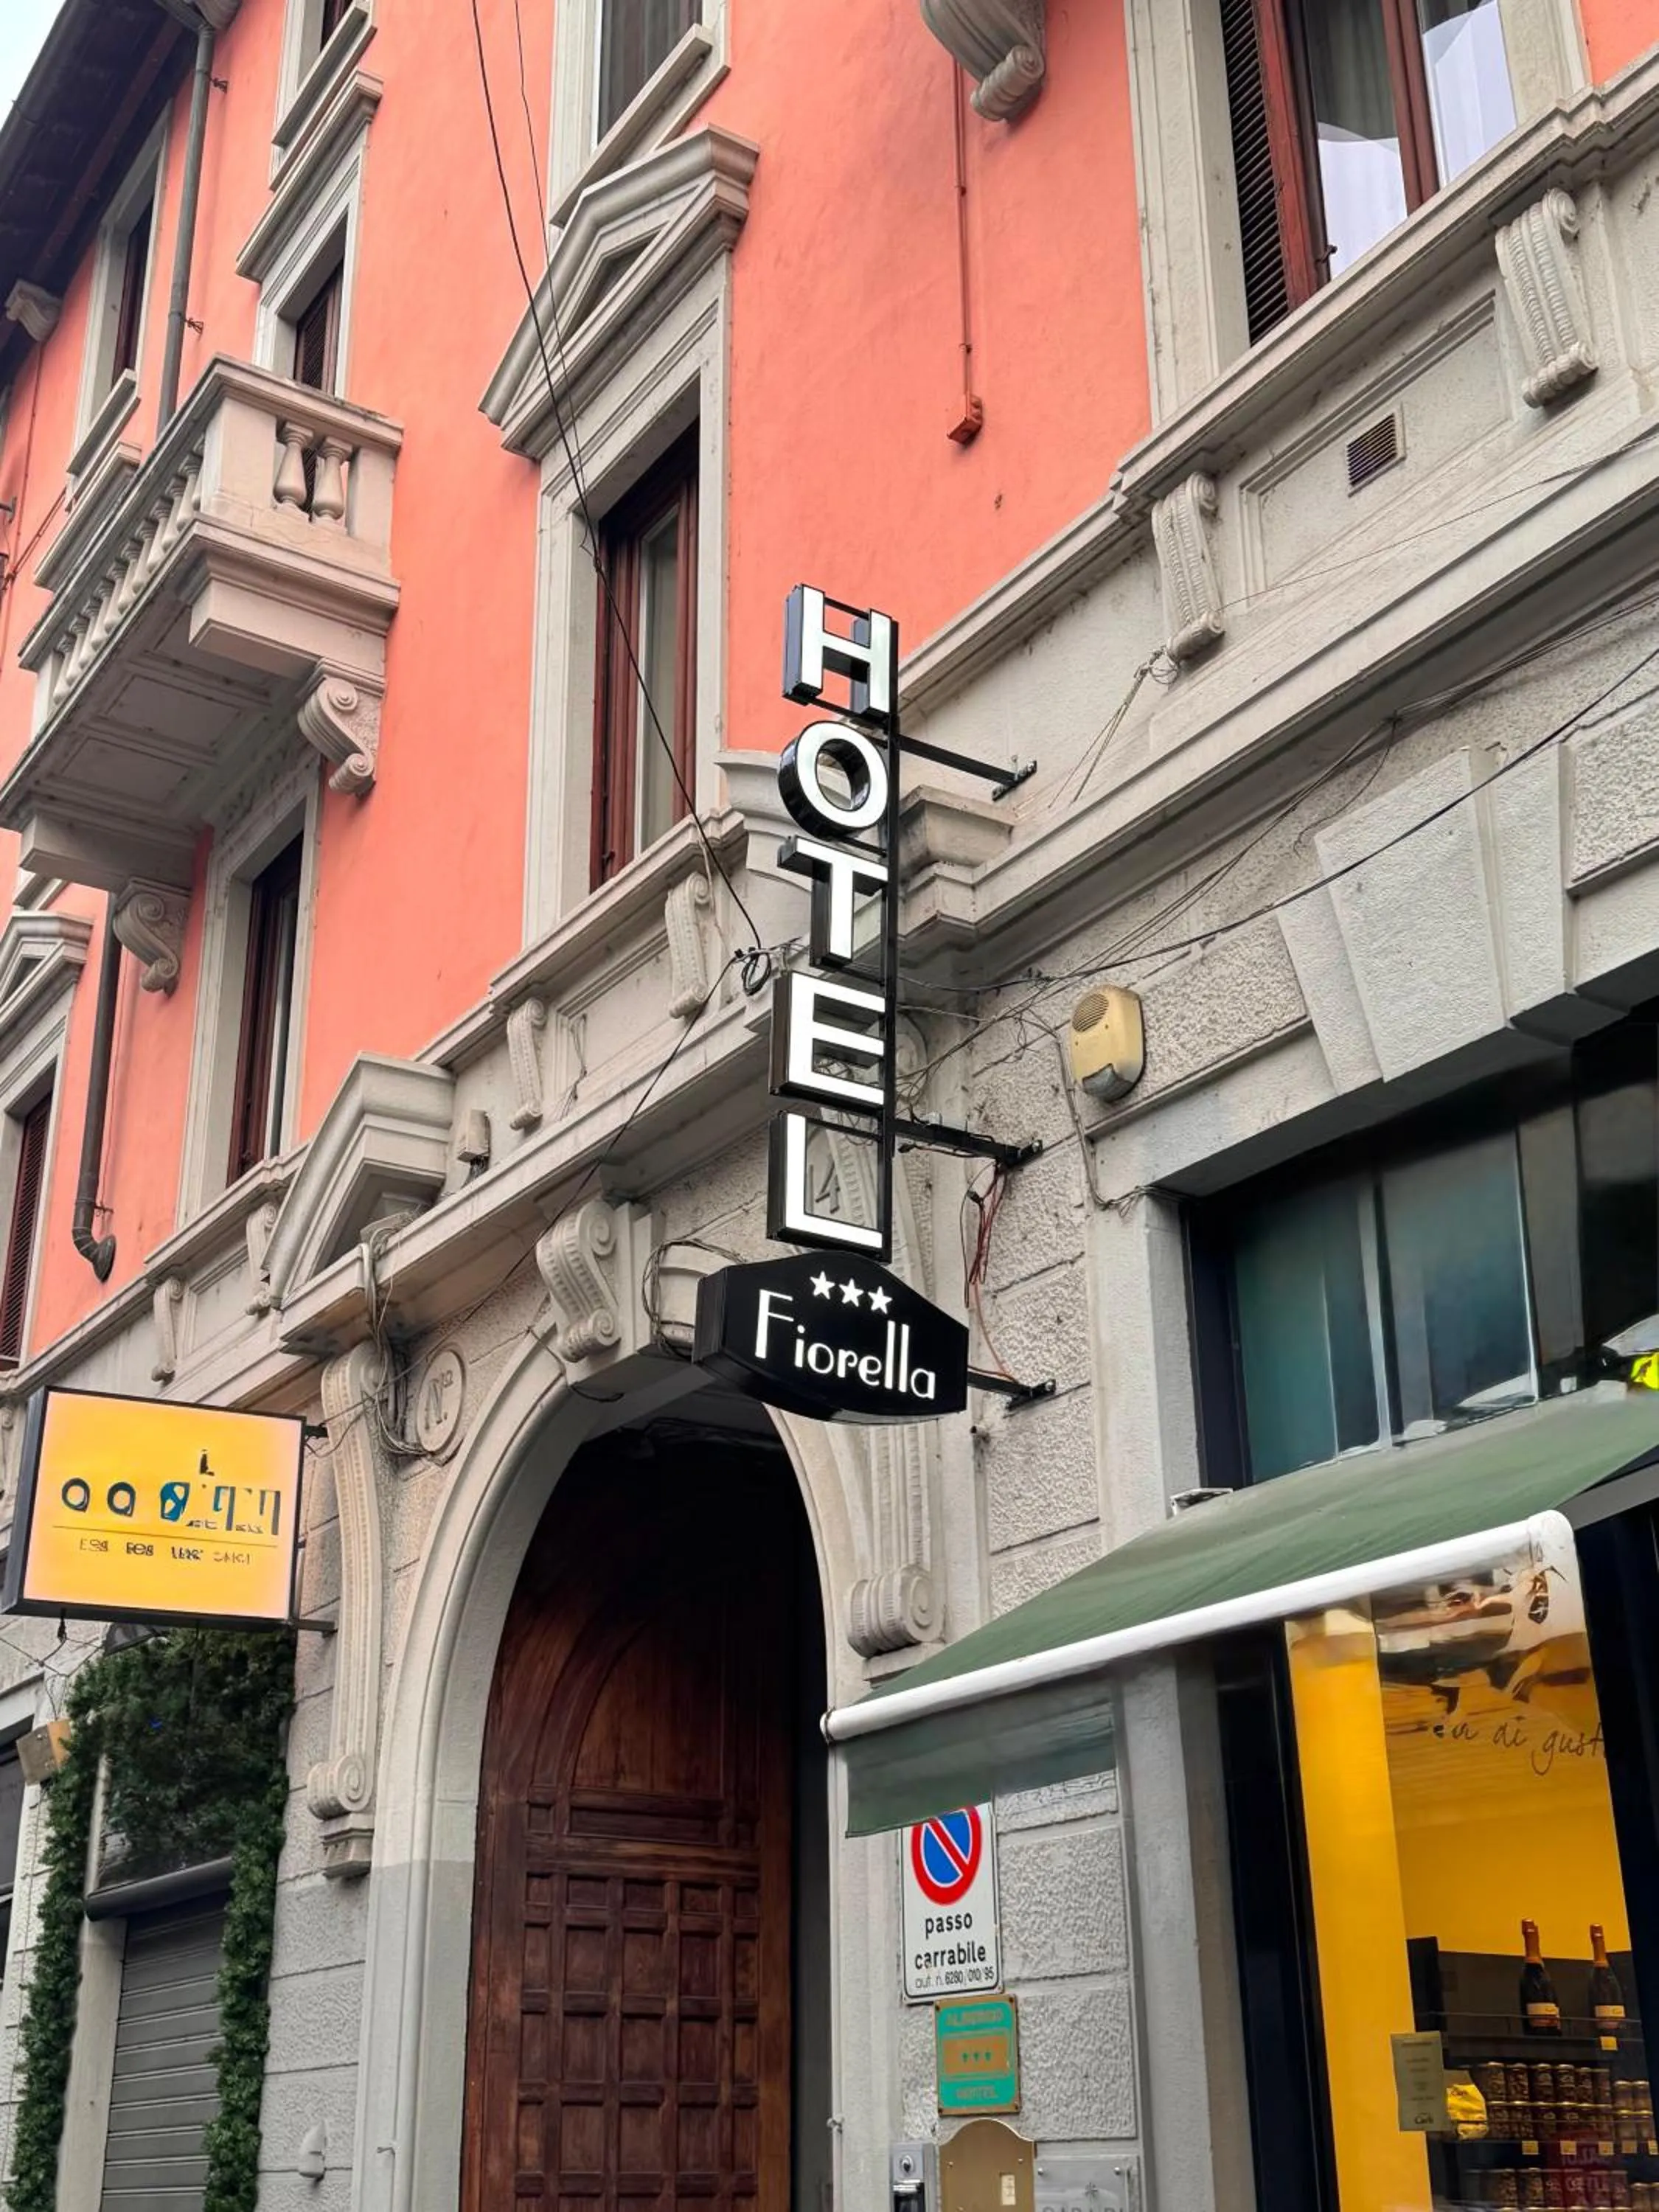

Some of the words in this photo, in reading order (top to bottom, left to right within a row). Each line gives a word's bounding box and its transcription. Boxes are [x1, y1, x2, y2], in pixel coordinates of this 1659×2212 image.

[785, 584, 891, 1249] HOTEL
[754, 1289, 936, 1400] Fiorella
[1531, 1722, 1605, 1775] gust
[925, 1912, 973, 1939] passo
[914, 1940, 987, 1970] carrabile
